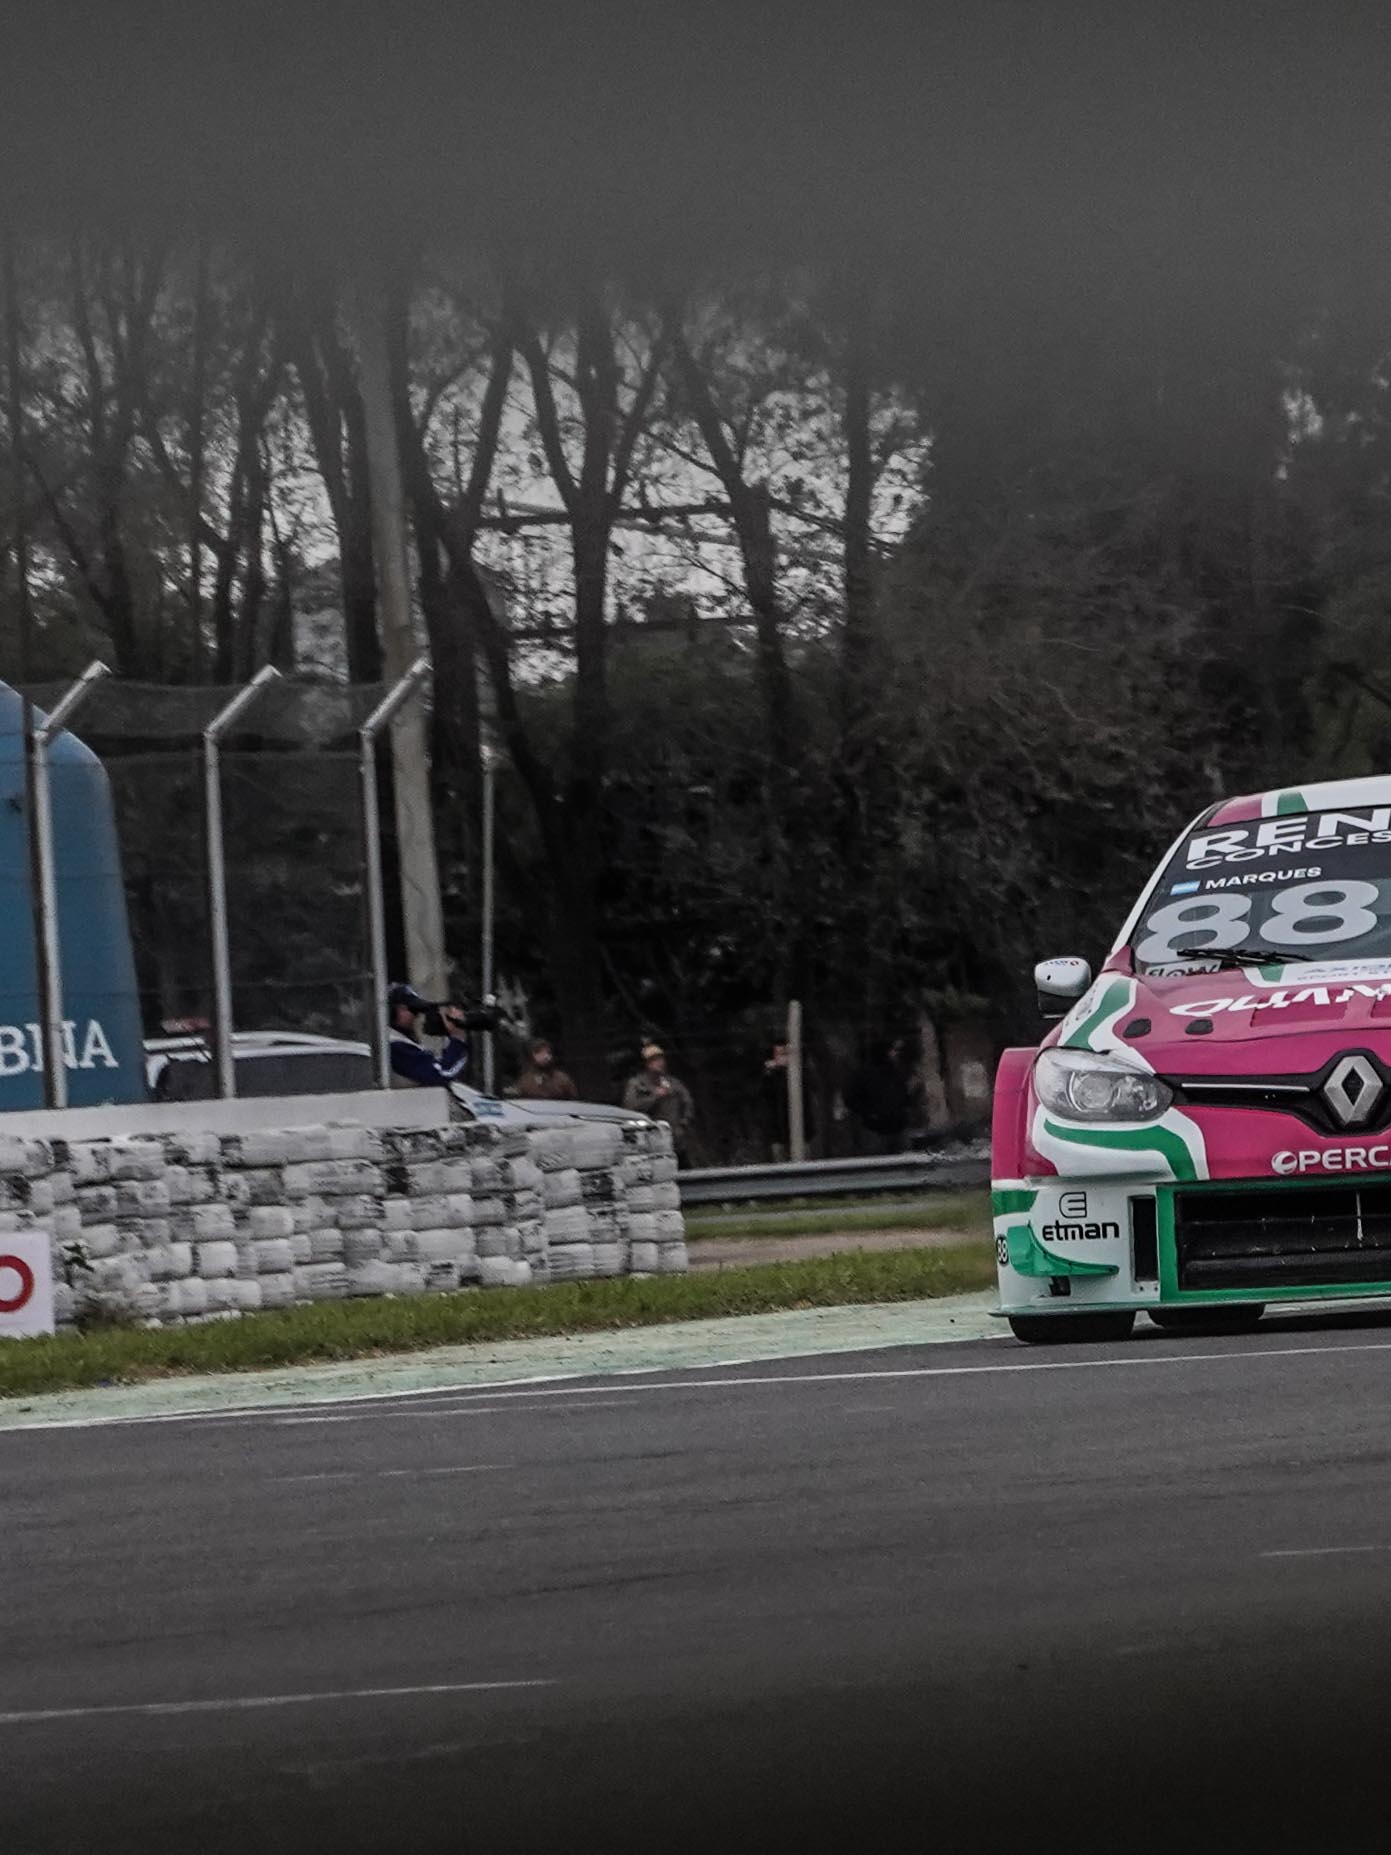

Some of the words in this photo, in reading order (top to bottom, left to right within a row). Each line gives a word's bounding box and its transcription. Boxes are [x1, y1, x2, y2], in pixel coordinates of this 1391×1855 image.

[1205, 866, 1322, 890] MARQUES
[1136, 880, 1379, 963] 88
[1042, 1220, 1120, 1241] etman
